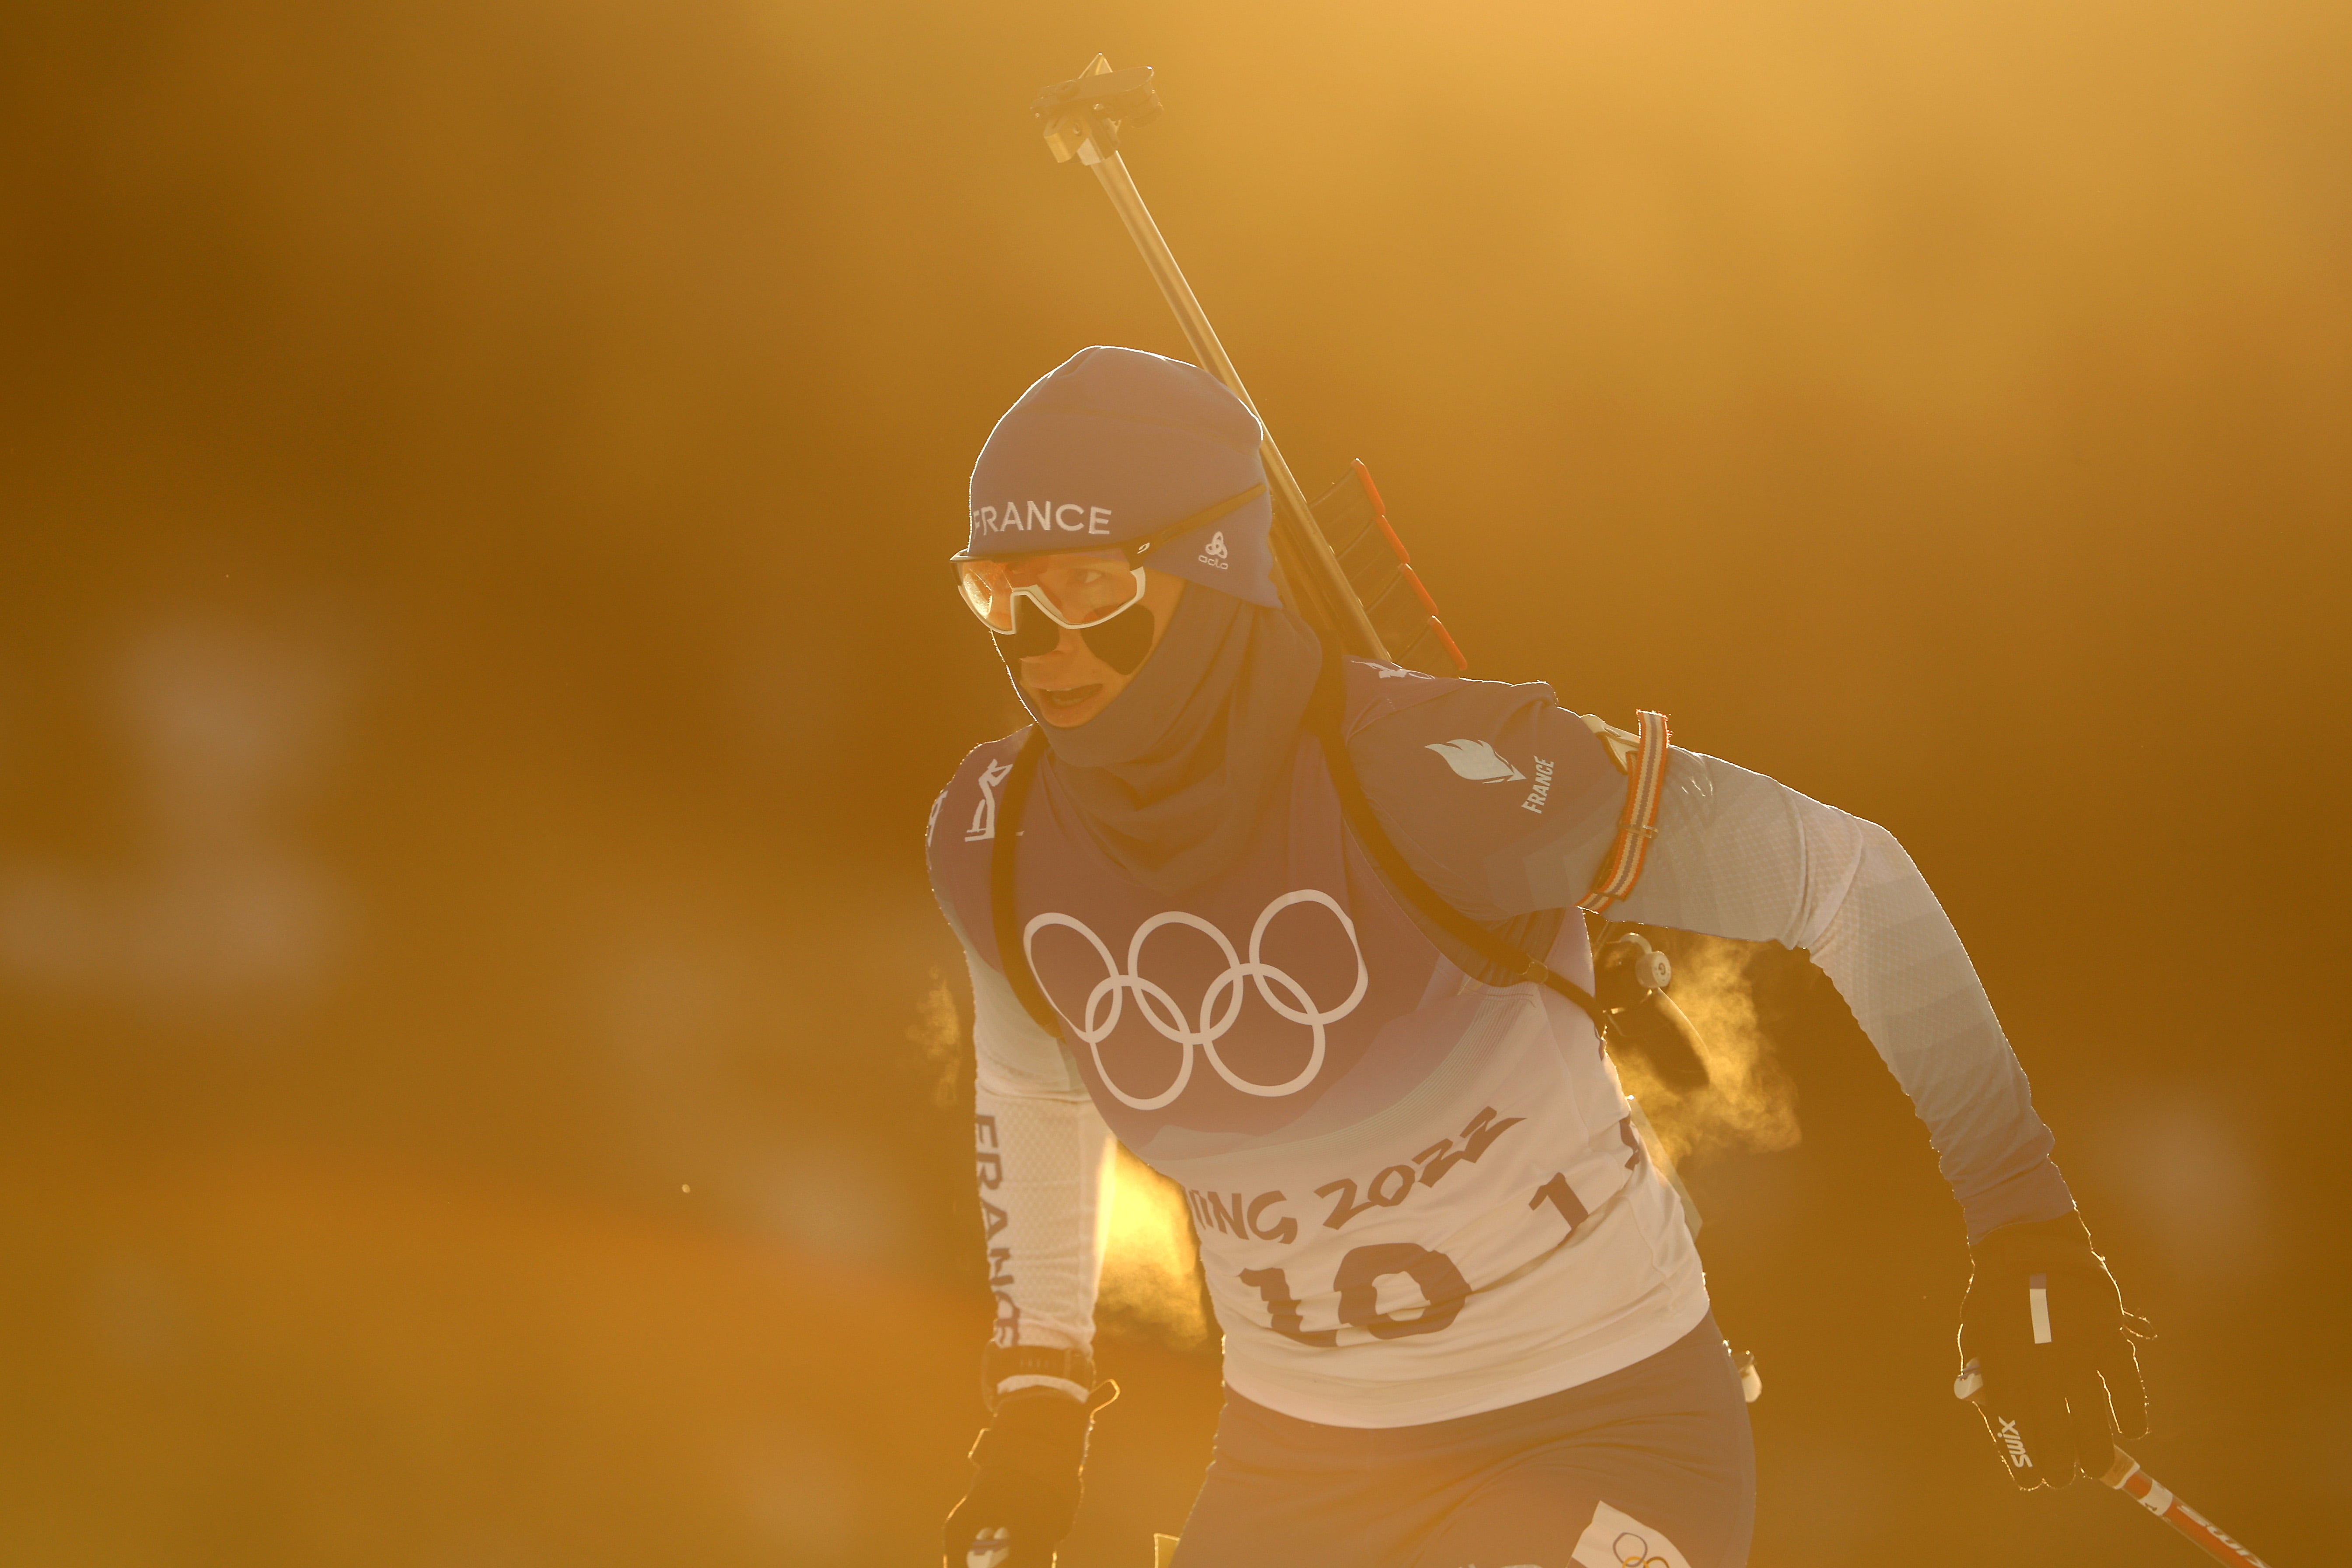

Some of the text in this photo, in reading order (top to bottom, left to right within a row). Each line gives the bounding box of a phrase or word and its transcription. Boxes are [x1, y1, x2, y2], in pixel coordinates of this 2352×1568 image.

[972, 500, 1112, 539] FRANCE
[1521, 755, 1554, 814] FRANCE
[1314, 1106, 1527, 1230] 2022
[1236, 1242, 1472, 1348] 10
[1997, 1416, 2033, 1468] swix
